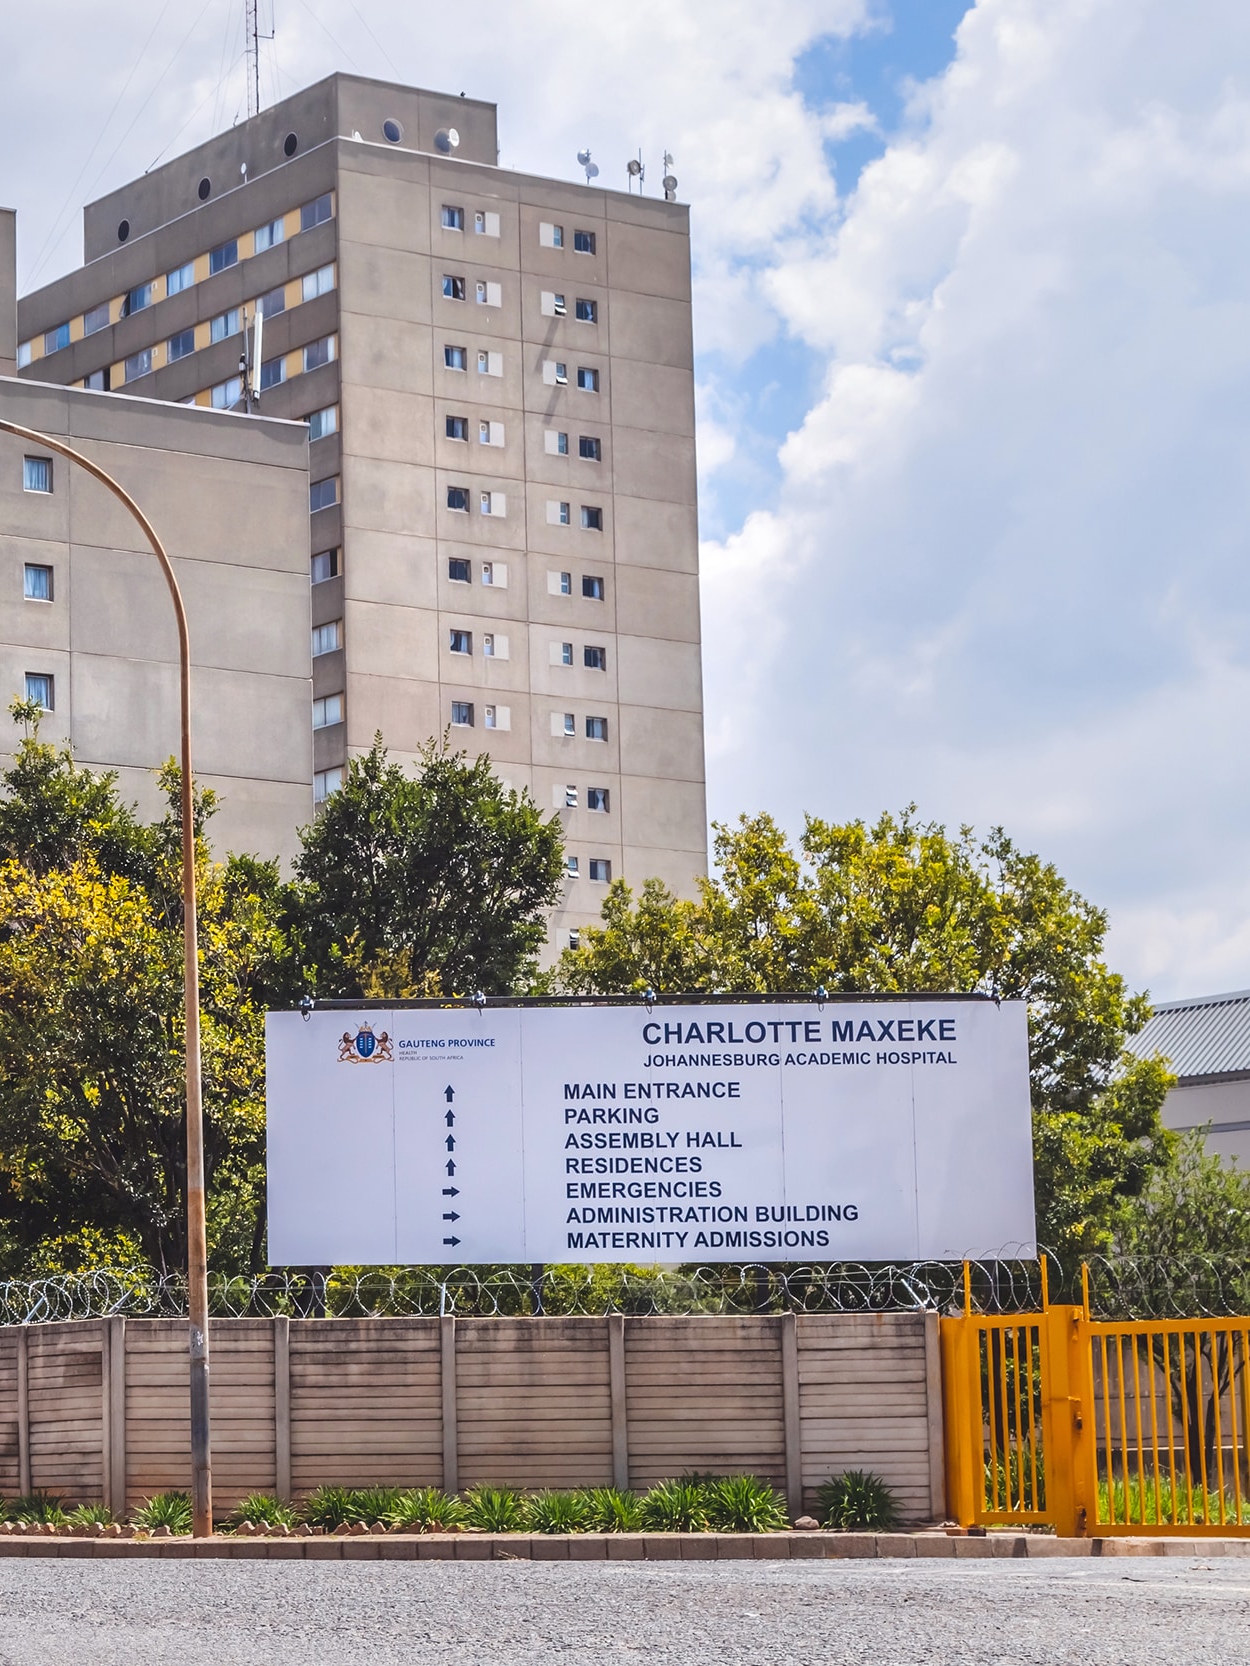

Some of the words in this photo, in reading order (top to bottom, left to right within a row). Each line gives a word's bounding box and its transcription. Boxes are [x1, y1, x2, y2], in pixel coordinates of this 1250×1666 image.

[642, 1020, 822, 1045] CHARLOTTE
[831, 1018, 957, 1043] MAXEKE
[398, 1039, 446, 1048] GAUTENG
[448, 1038, 496, 1048] PROVINCE
[643, 1052, 780, 1068] JOHANNESBURG
[784, 1051, 871, 1067] ACADEMIC
[876, 1050, 958, 1066] HOSPITAL
[564, 1083, 617, 1100] MAIN
[623, 1081, 741, 1100] ENTRANCE
[564, 1107, 659, 1125] PARKING
[564, 1131, 680, 1150] ASSEMBLY
[686, 1131, 743, 1148] HALL
[565, 1156, 703, 1174] RESIDENCES
[566, 1180, 722, 1199] EMERGENCIES
[565, 1205, 748, 1224] ADMINISTRATION
[755, 1204, 859, 1223] BUILDING
[567, 1231, 689, 1249] MATERNITY
[693, 1229, 830, 1248] ADMISSIONS
